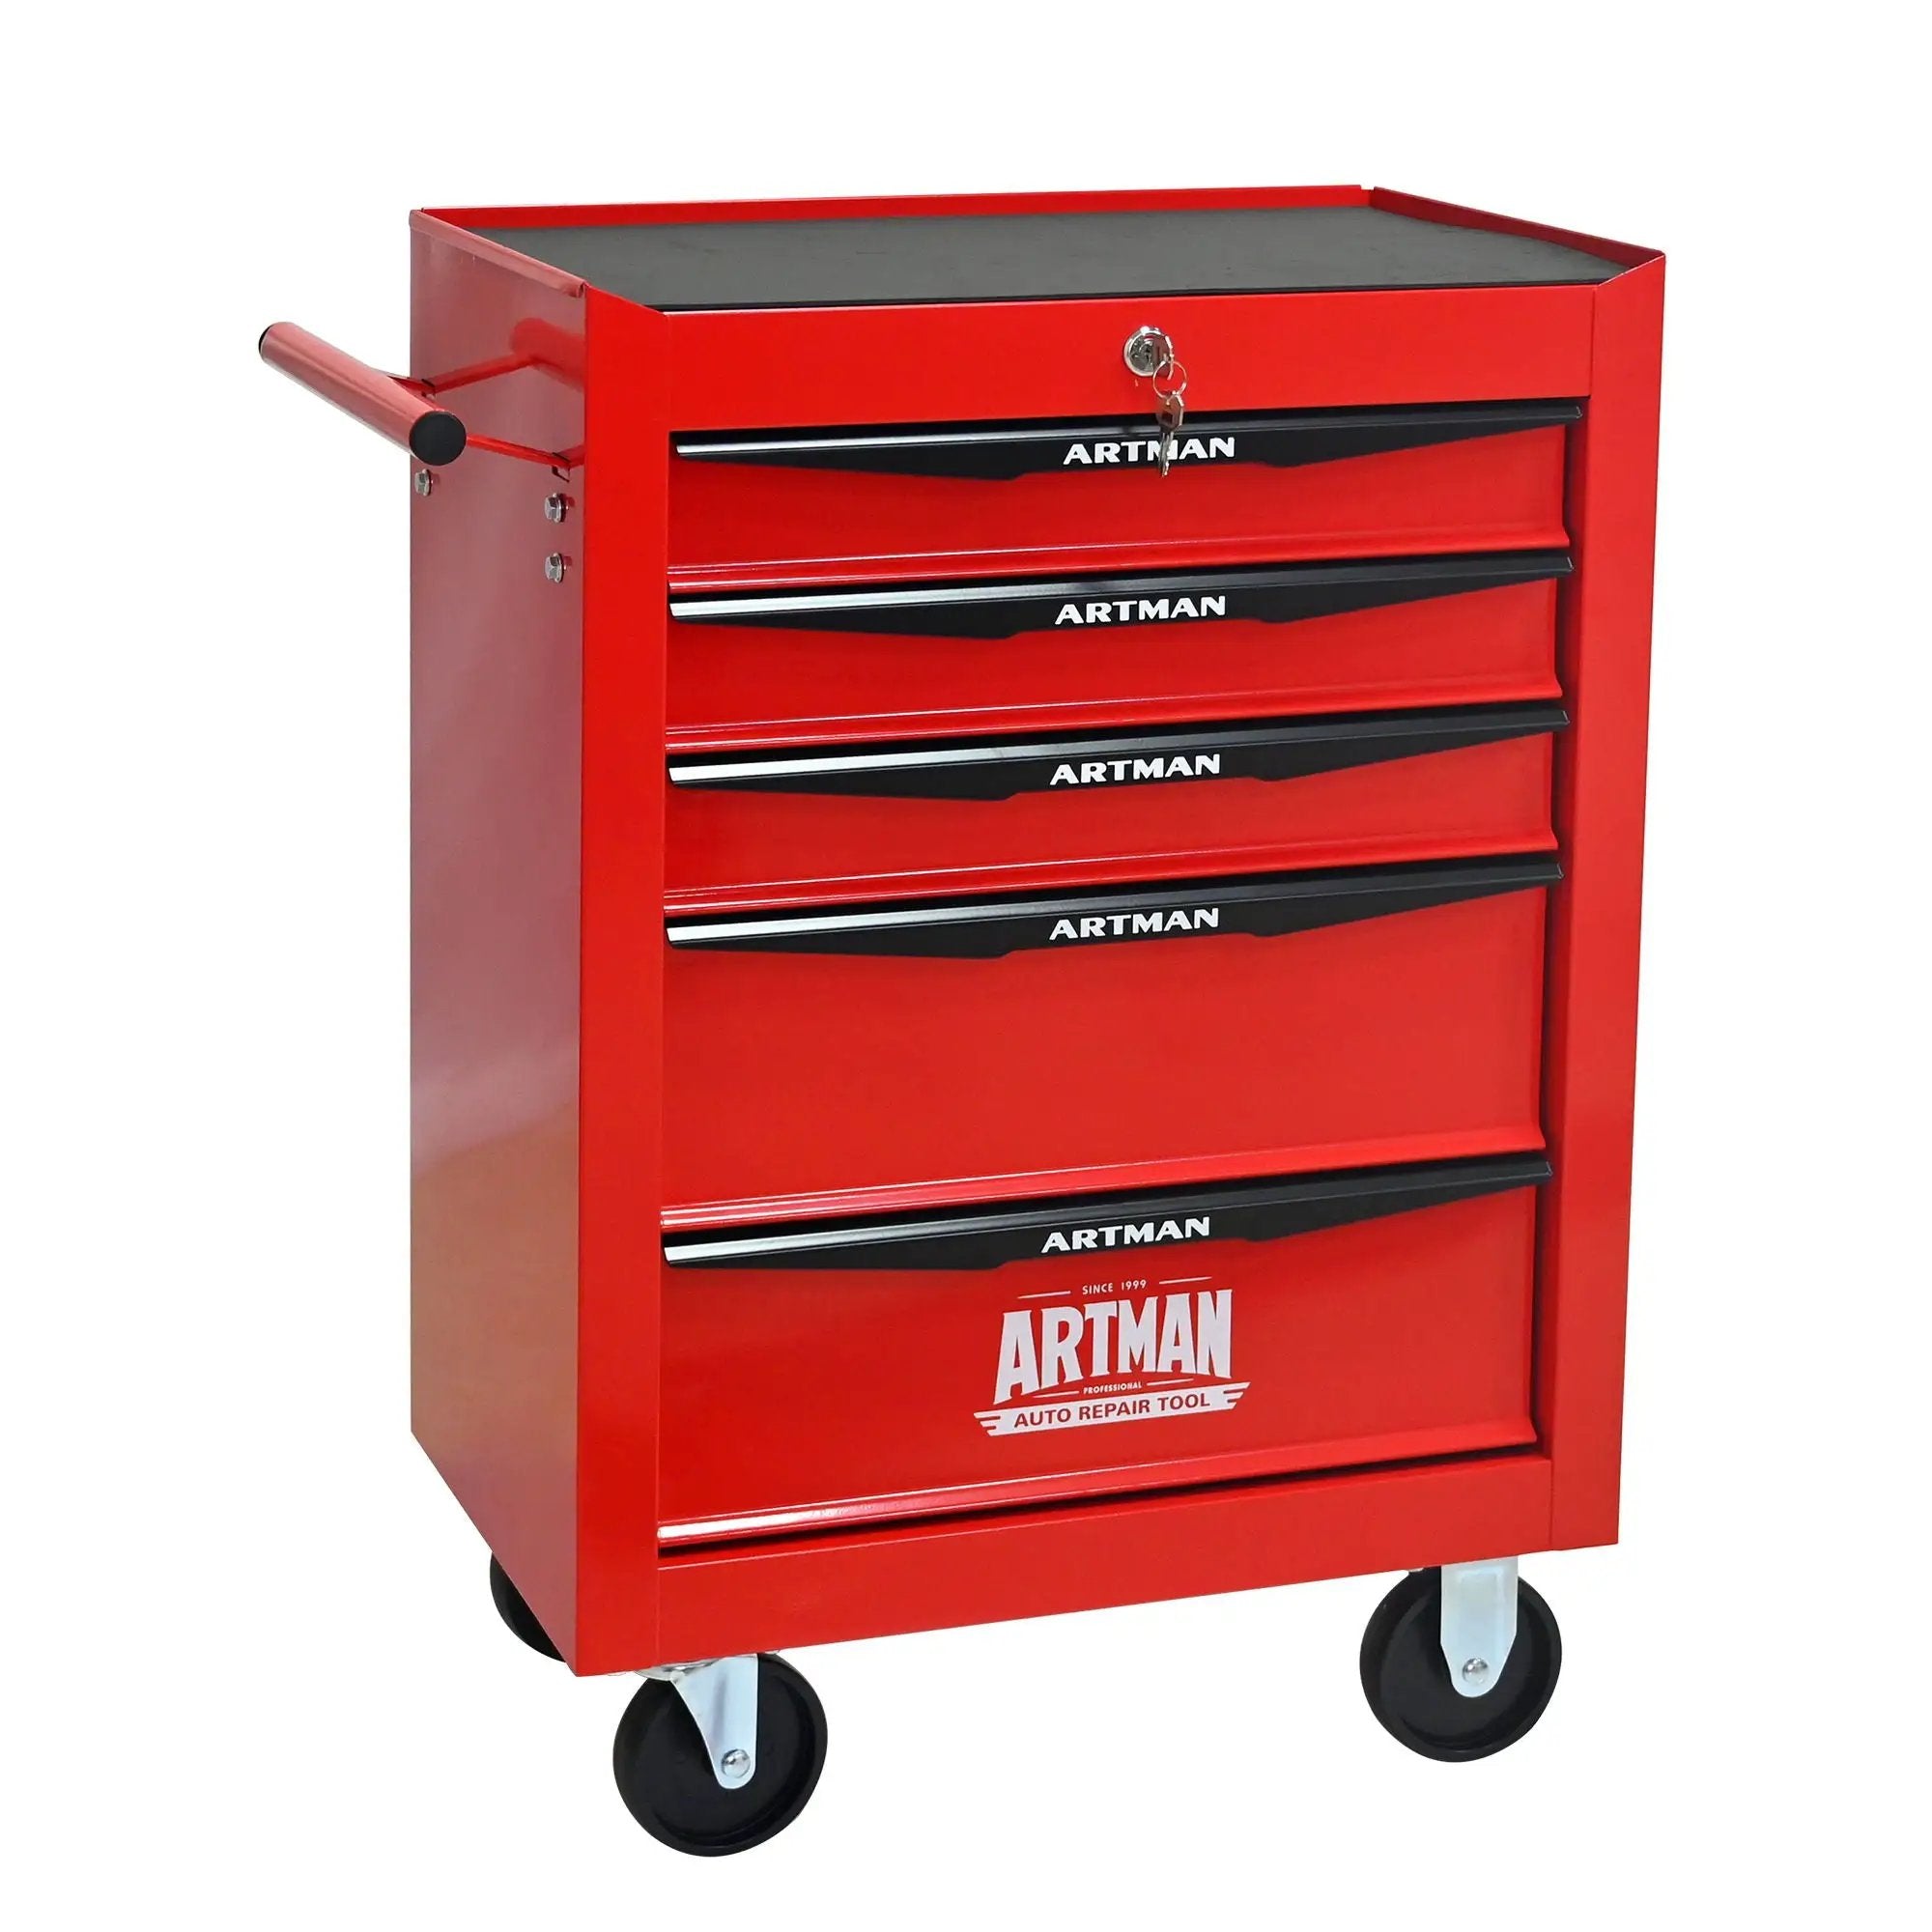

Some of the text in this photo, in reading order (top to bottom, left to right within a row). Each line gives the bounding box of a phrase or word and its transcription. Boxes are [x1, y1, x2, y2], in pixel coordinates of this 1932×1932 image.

[1055, 595, 1226, 625] ARTMAN
[1049, 753, 1220, 785] ARTMAN
[1048, 908, 1219, 940] ARTMAN
[1041, 1216, 1210, 1254] ARTMAN
[1082, 1279, 1147, 1295] SINCE 1999
[993, 1289, 1233, 1406] ARTMAN
[1083, 1380, 1143, 1395] PROFESSIONAL
[1013, 1393, 1210, 1429] AUTO REPAIR TOOL
